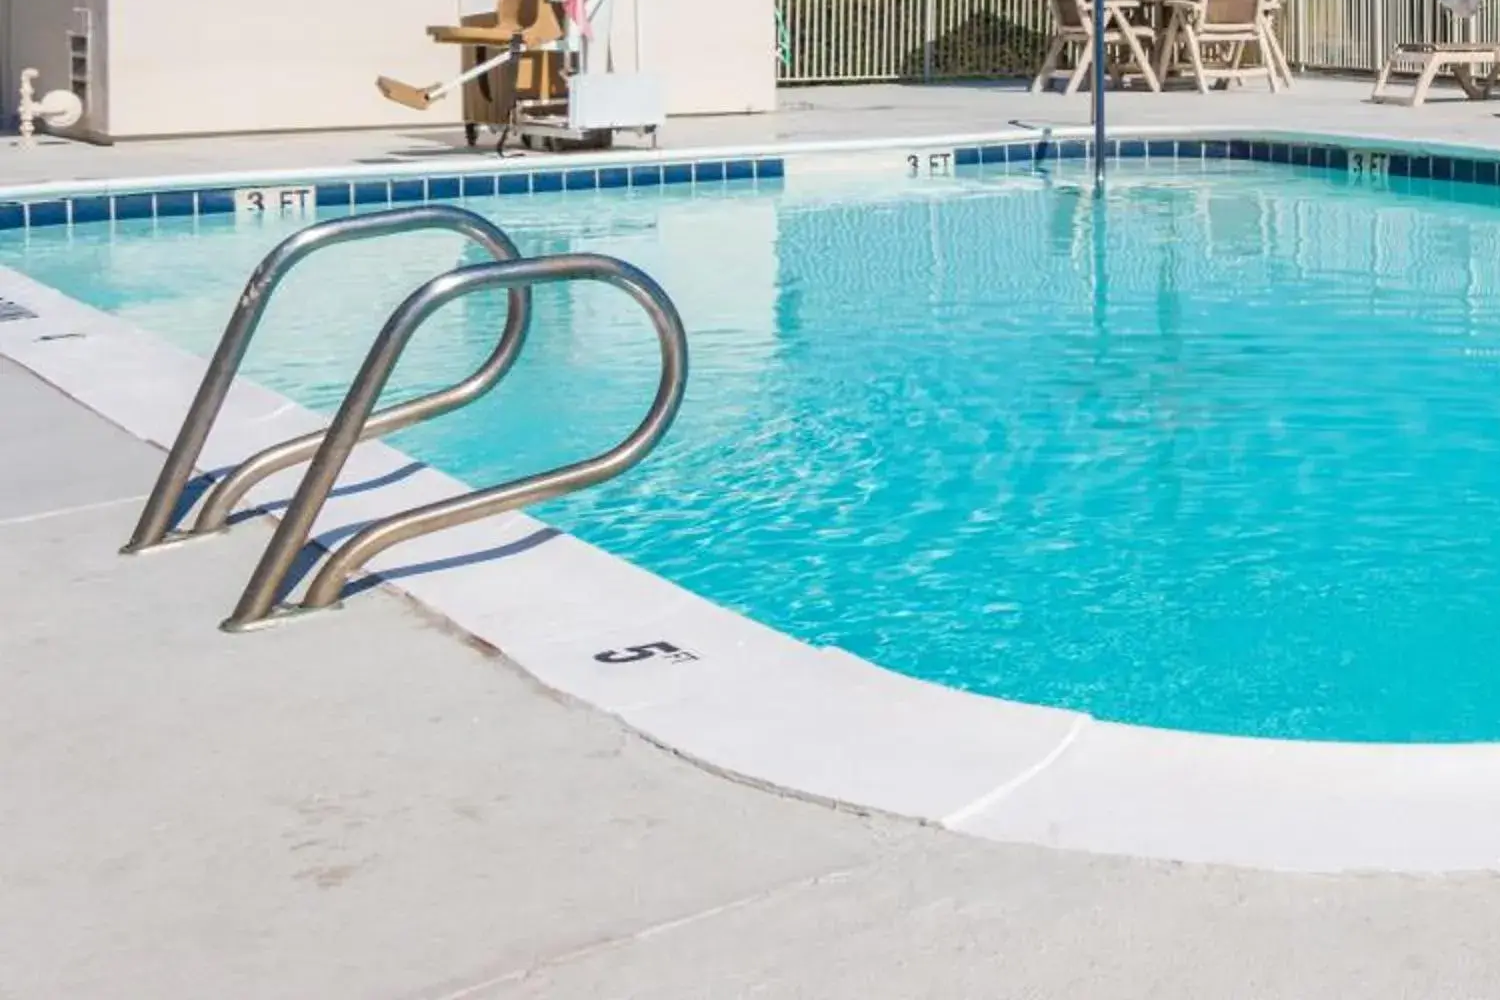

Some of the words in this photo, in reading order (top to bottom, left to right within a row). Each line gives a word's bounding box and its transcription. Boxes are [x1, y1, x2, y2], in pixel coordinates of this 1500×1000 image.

[907, 154, 919, 169] 3
[929, 153, 951, 168] FT
[247, 191, 265, 211] 3
[280, 189, 311, 209] FT
[593, 641, 680, 663] 5
